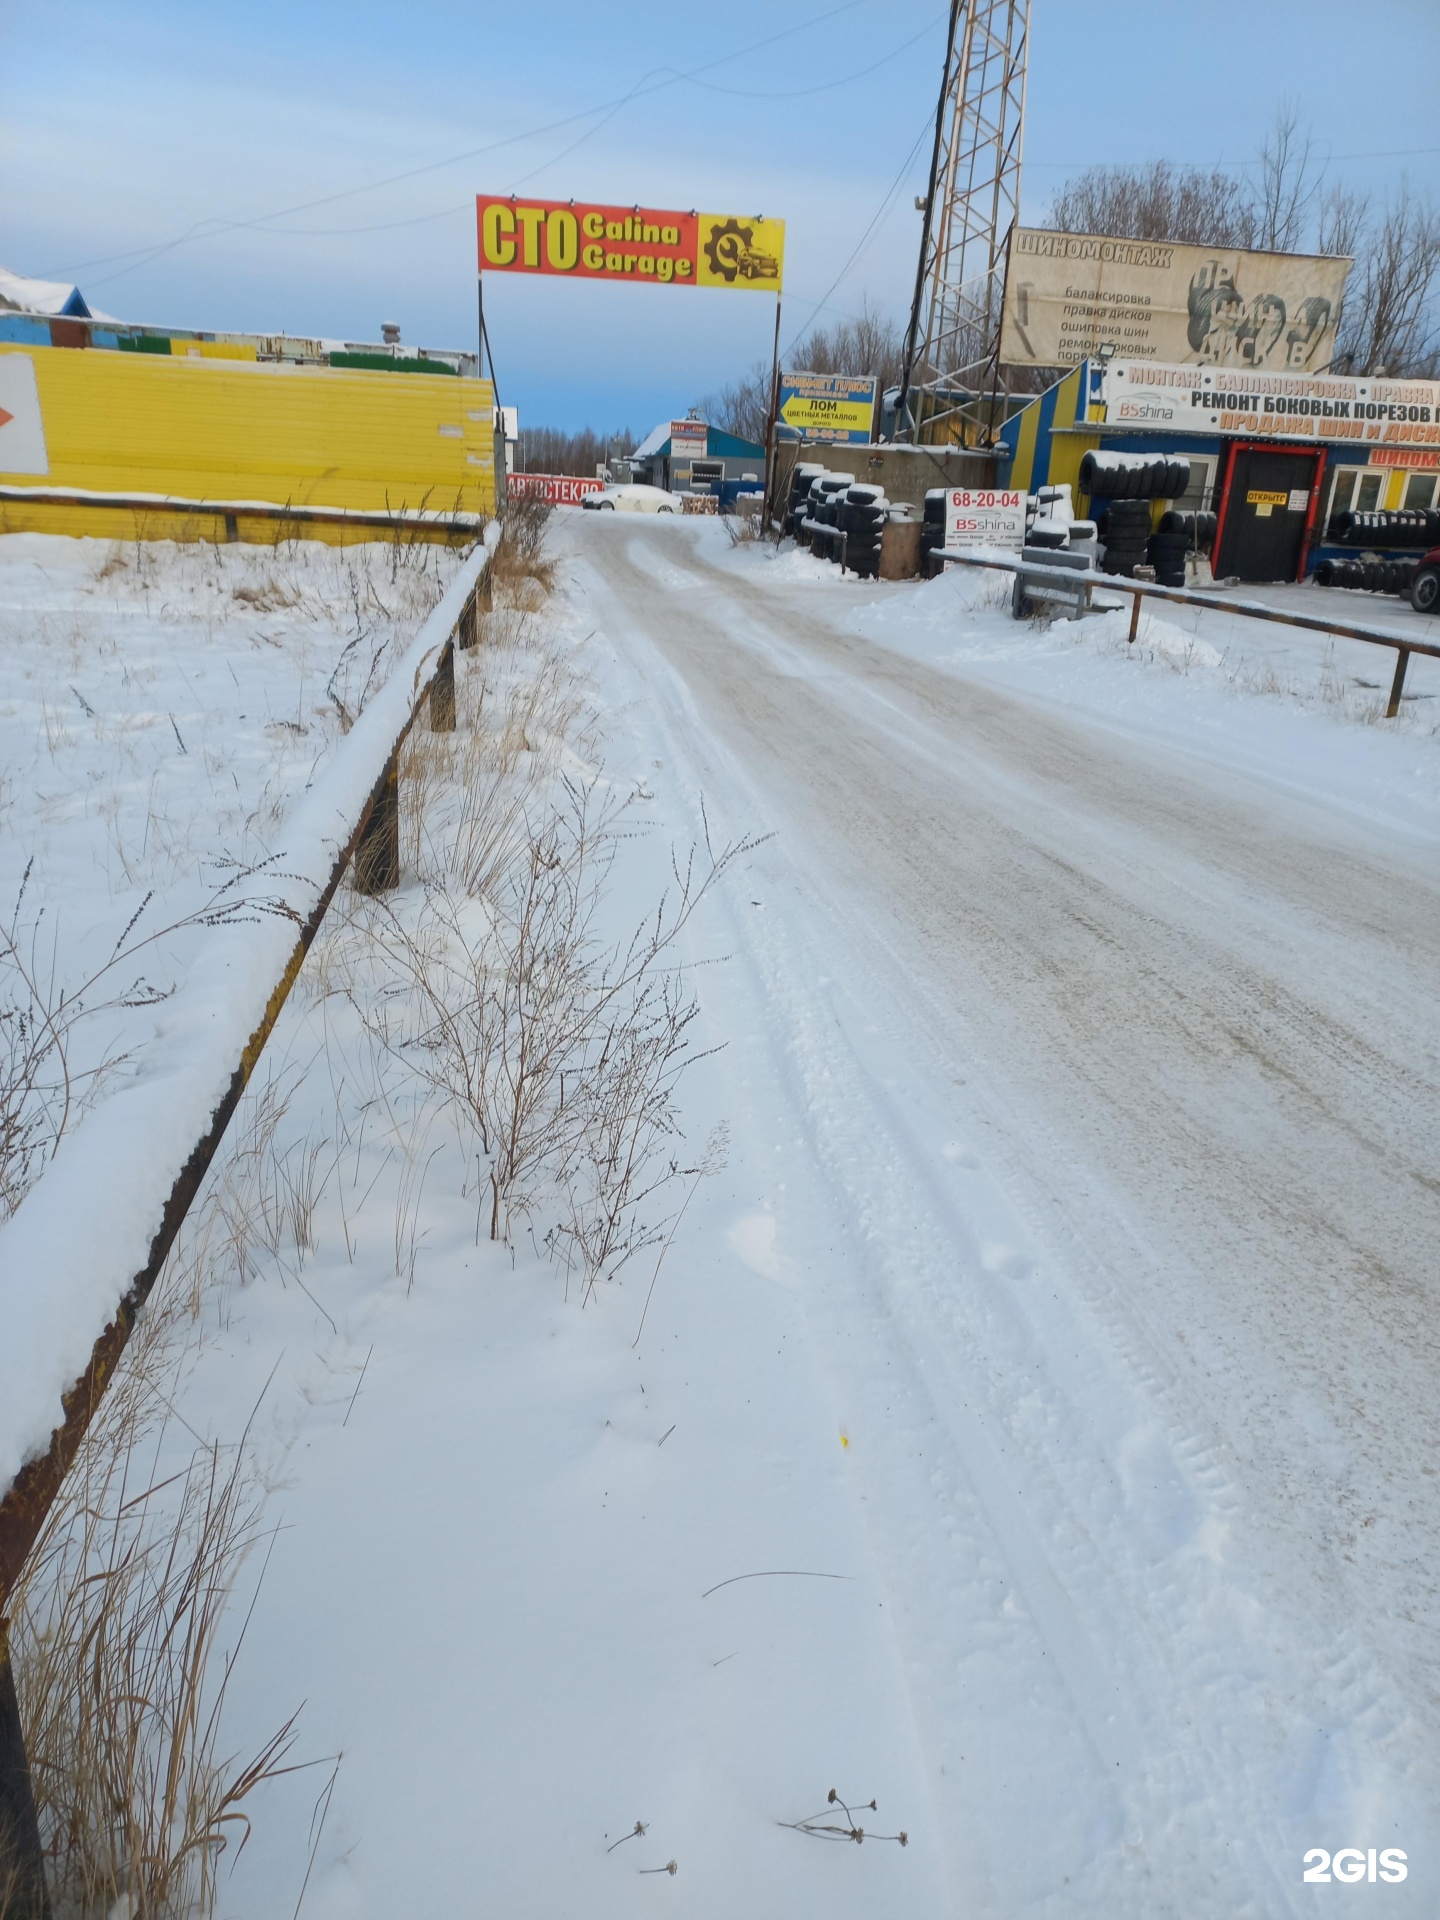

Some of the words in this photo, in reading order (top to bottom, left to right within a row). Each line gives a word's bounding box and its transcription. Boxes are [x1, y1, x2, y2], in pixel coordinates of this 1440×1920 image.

[482, 204, 579, 270] СТО
[582, 212, 679, 245] Galina
[1016, 234, 1174, 268] ШИНОМОНТАЖ
[582, 244, 691, 282] Garage
[1065, 286, 1151, 305] балансировка
[1063, 305, 1106, 318] правка
[1109, 308, 1152, 321] дисков
[1061, 321, 1121, 335] ошиповка
[1124, 327, 1149, 338] шин
[834, 380, 872, 394] ПЛЮС
[1128, 367, 1202, 389] МОНТАЖ
[1215, 373, 1357, 400] БАЛЛАНСИРОВКА
[1371, 384, 1433, 404] ПРАВКА
[810, 399, 837, 411] ЛОМ
[1120, 402, 1174, 420] BSshina
[1191, 391, 1260, 412] РЕМОНТ
[1264, 396, 1350, 418] БОКОВЫХ
[1354, 402, 1431, 423] ПОРЕЗОВ
[787, 410, 820, 419] ЦВЕТНЫХ
[821, 412, 858, 421] МЕТАЛЛОВ
[1219, 412, 1314, 435] ПРОДАЖА
[1318, 418, 1364, 438] ШИН
[1372, 449, 1440, 467] ШИНОМ
[953, 492, 1019, 507] 68-20-04
[956, 519, 1016, 530] BSshina
